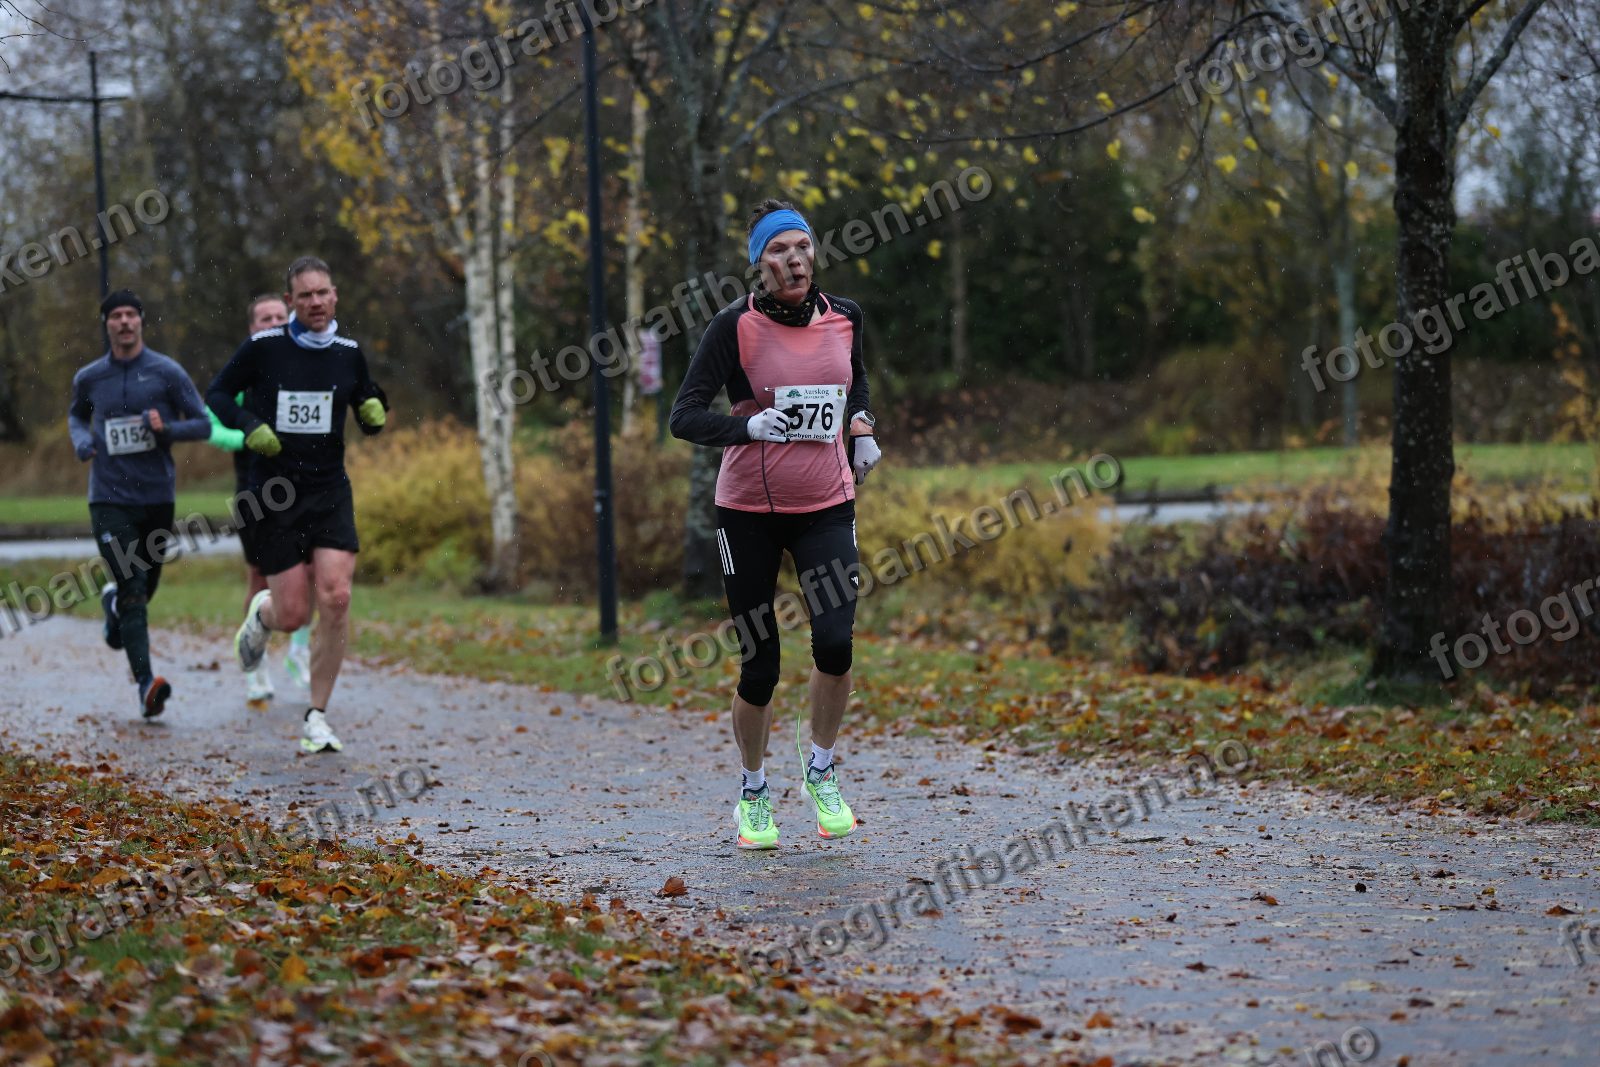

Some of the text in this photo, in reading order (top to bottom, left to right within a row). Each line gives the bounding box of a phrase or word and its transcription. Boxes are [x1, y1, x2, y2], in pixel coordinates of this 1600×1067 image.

[288, 404, 321, 424] 534
[789, 403, 834, 431] 576
[110, 426, 150, 446] 9152
